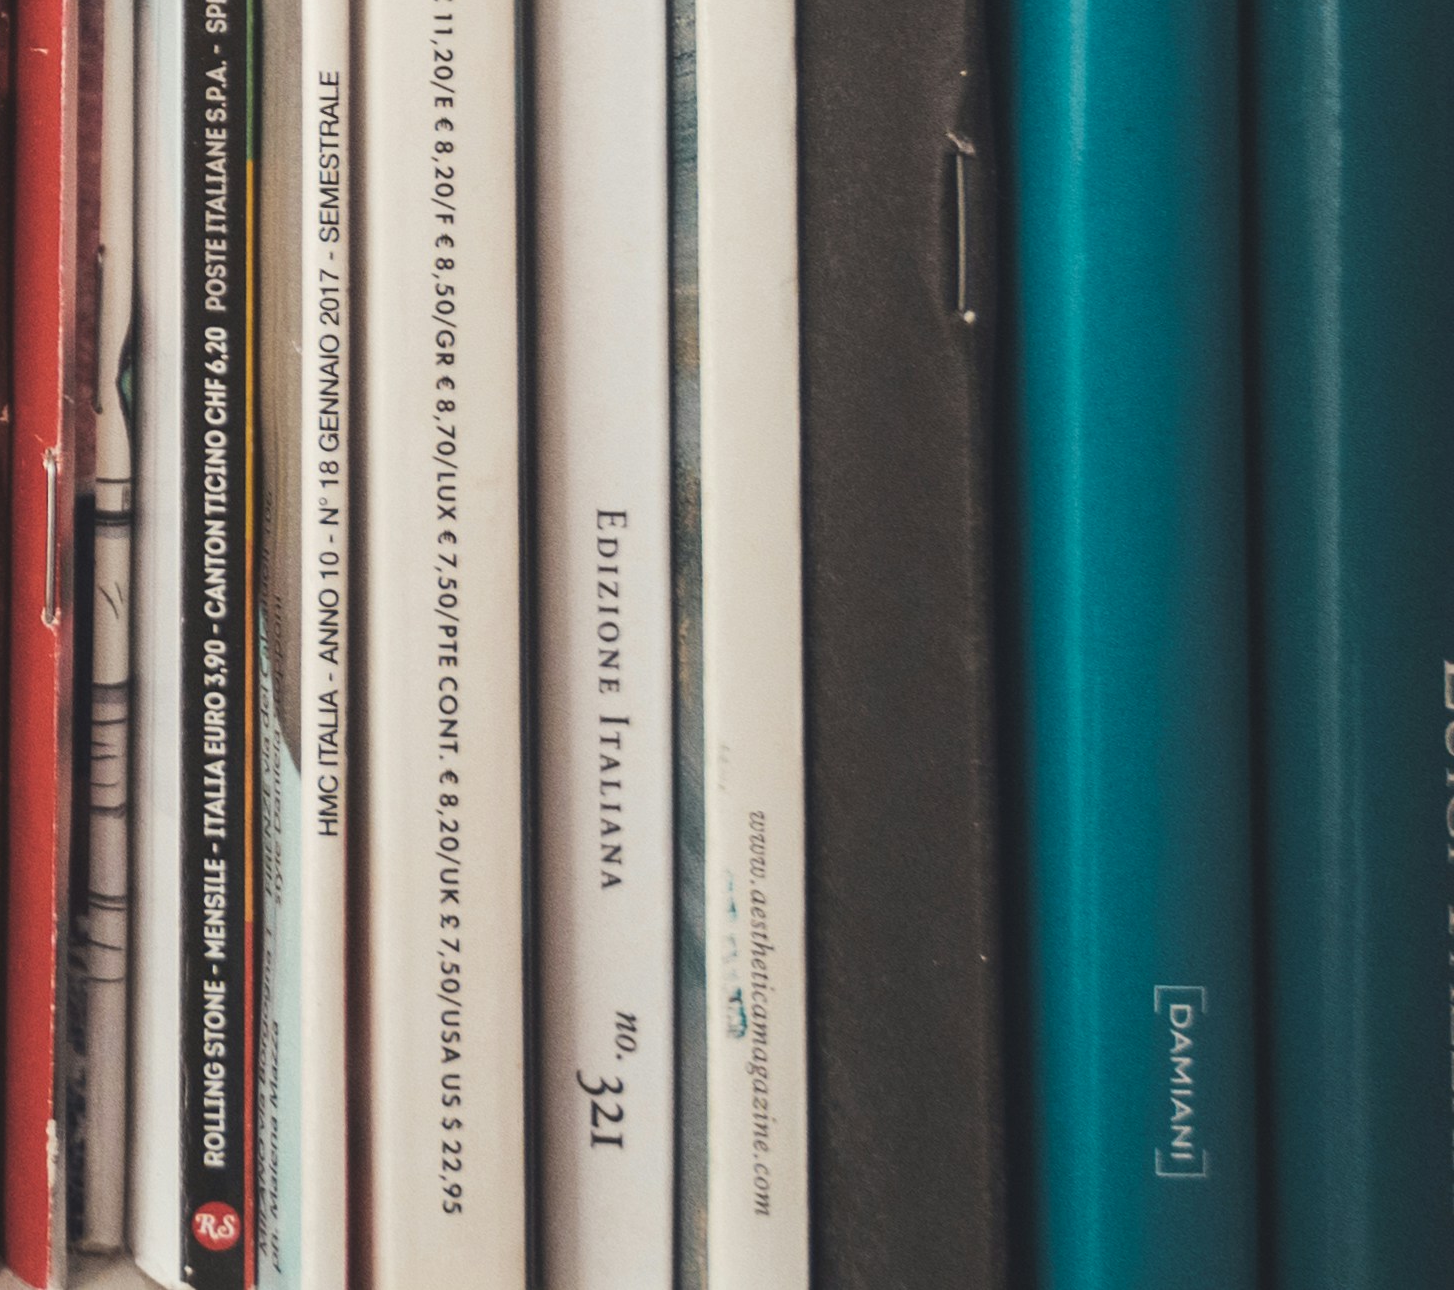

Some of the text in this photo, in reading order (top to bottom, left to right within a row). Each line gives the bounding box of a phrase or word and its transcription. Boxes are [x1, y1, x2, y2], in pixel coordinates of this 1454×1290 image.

[204, 59, 228, 123] S.P.A.
[204, 126, 228, 234] ITALIANE
[317, 71, 340, 243] SEMESTRALE
[203, 237, 227, 312] POSTE
[318, 267, 340, 326] 2017
[203, 325, 229, 375] 6,20
[203, 376, 227, 426] CHF
[317, 333, 340, 453] GENNAIO
[202, 428, 228, 516] TICINO
[318, 459, 339, 488] 18
[202, 518, 227, 619] CANTON
[318, 550, 340, 579] 10
[202, 638, 228, 687] 3,90
[317, 587, 340, 665] ANNO
[202, 690, 227, 756] EURO
[317, 688, 339, 766] ITALIA
[595, 506, 631, 892] EDIZIONE ITALIANA
[202, 758, 227, 839] ITALIA
[316, 774, 339, 837] HMC
[202, 857, 227, 959] MENSILE
[202, 978, 226, 1057] STONE
[613, 1009, 640, 1061] no.
[745, 809, 774, 1217] www.aestheticamagazine.com
[202, 1060, 226, 1167] ROLLING
[576, 1071, 627, 1150] 321
